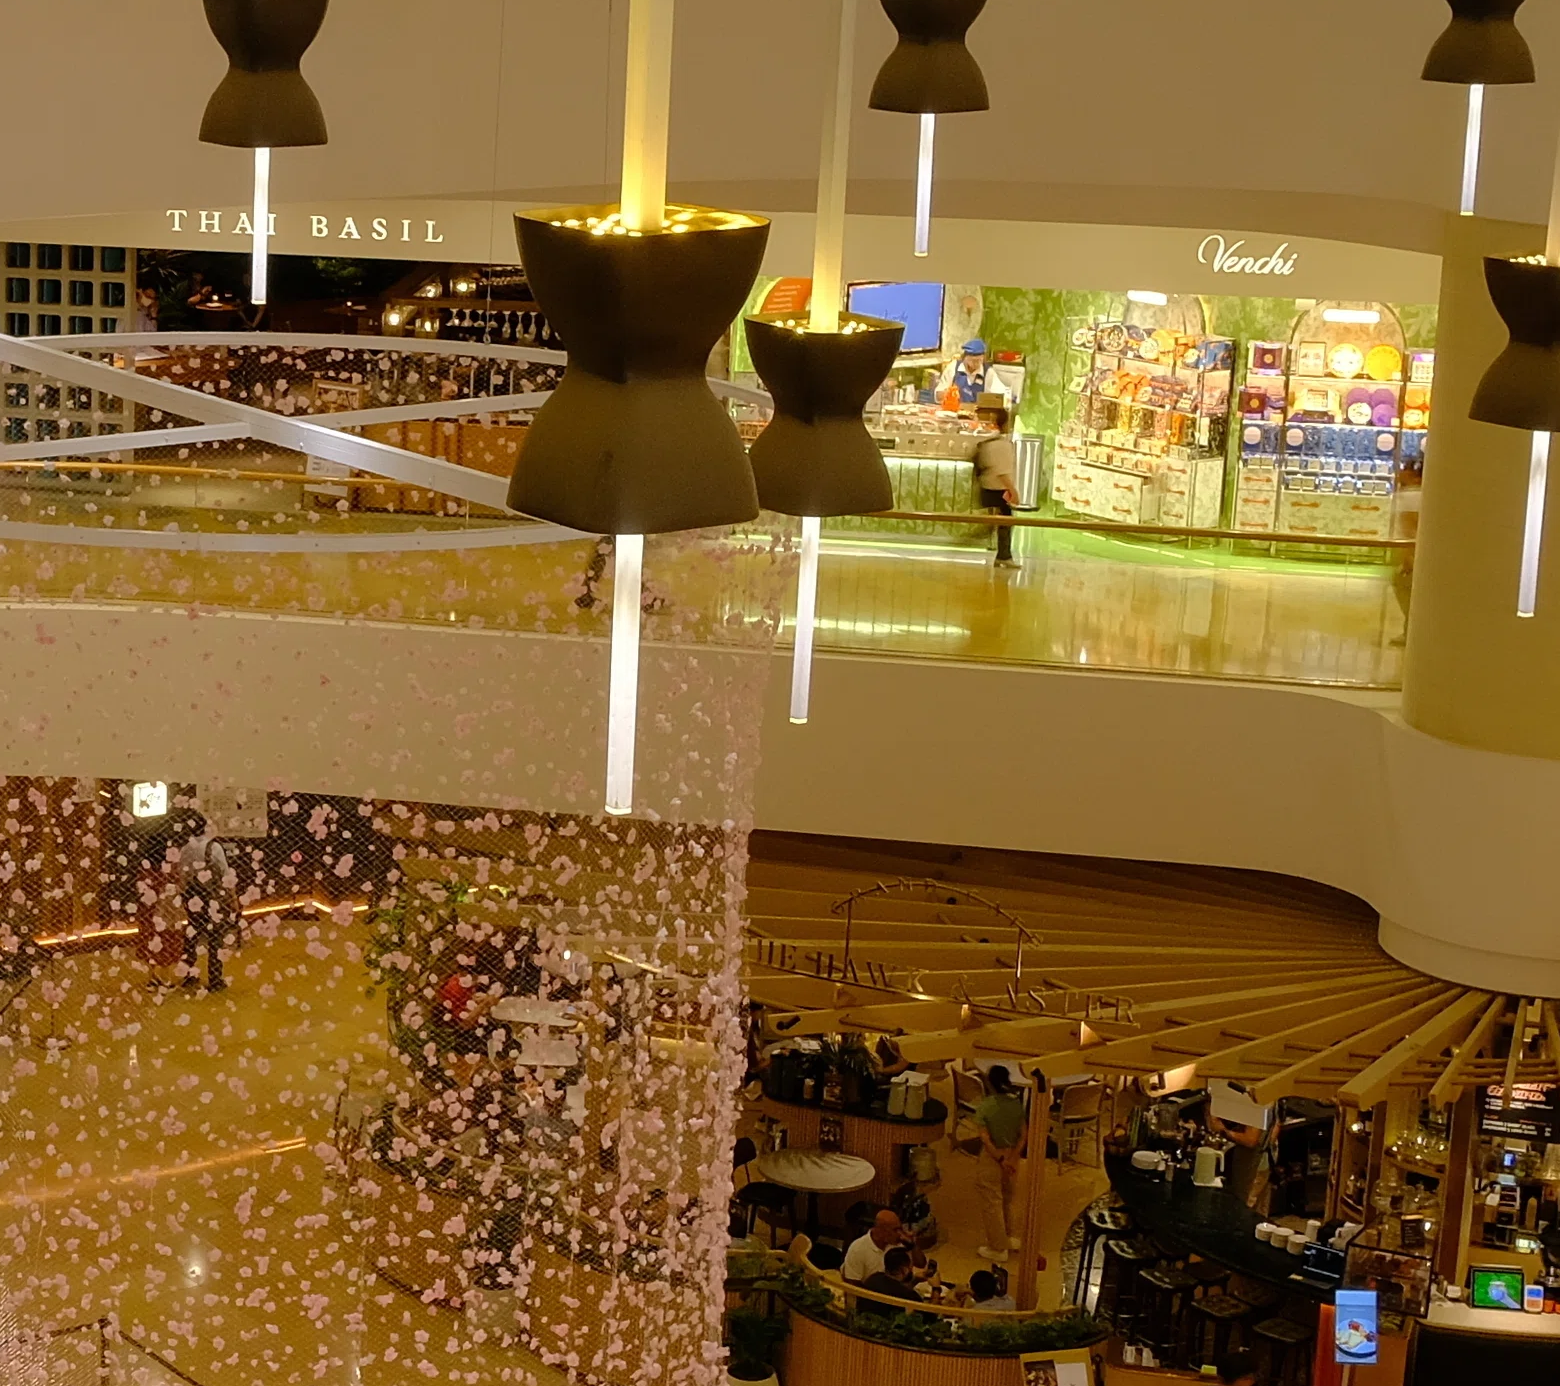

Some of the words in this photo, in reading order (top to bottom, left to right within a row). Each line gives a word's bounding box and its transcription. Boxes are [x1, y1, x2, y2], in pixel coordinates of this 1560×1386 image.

[166, 209, 277, 236] THAI
[310, 215, 444, 243] BASIL
[1197, 234, 1298, 276] Venchi
